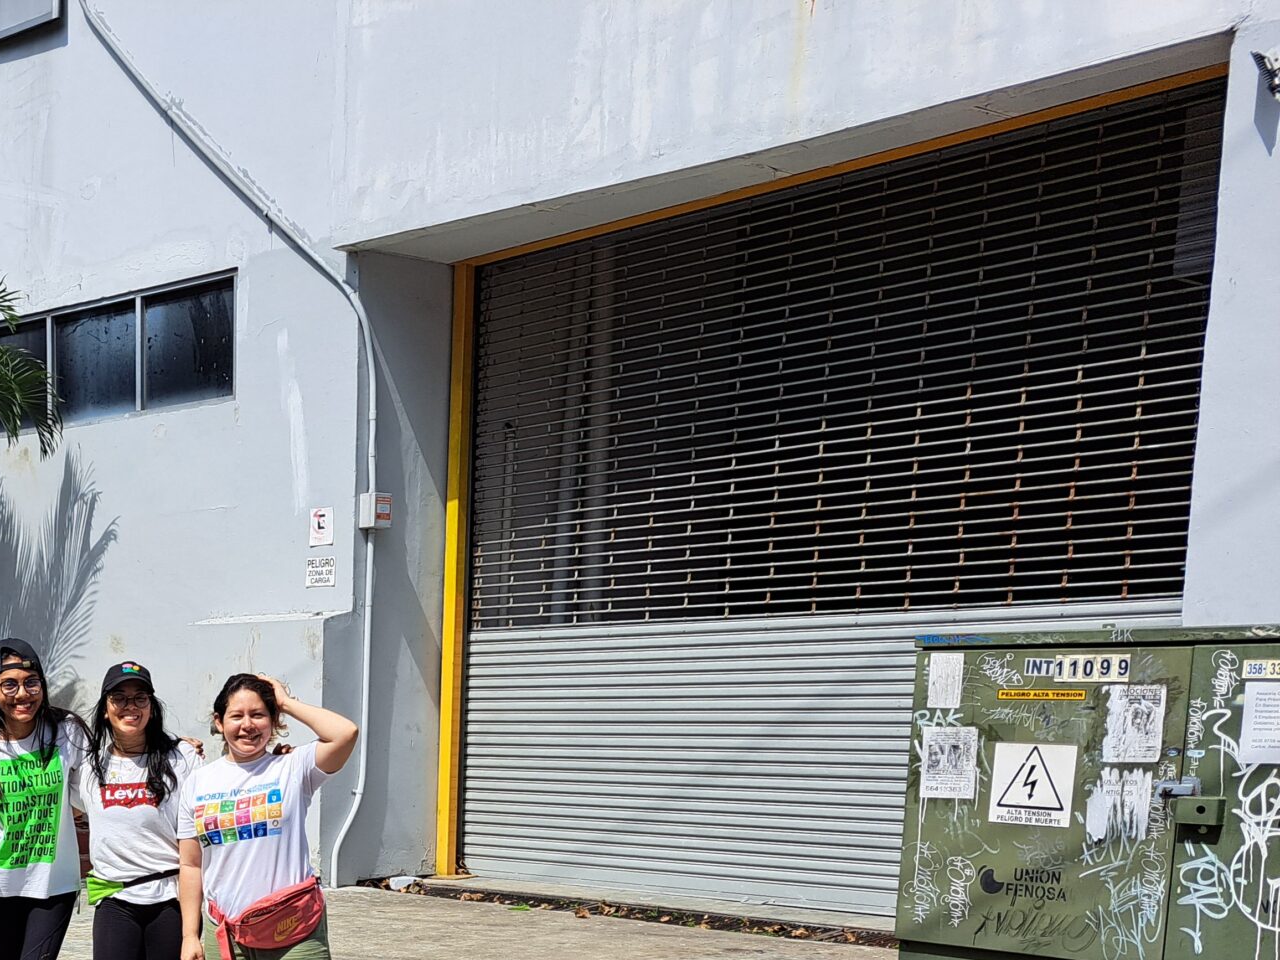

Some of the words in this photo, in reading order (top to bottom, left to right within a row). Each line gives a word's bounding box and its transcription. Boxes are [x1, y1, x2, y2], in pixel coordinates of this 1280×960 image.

[307, 557, 335, 569] PELIGRO
[308, 569, 324, 577] ZONA
[325, 568, 333, 576] DE
[310, 576, 331, 584] CARGA
[1025, 659, 1054, 675] INT
[1055, 659, 1129, 677] 11099
[1120, 688, 1162, 696] MOCIONES
[1024, 810, 1052, 818] TENSION
[996, 815, 1023, 823] PELIGRO
[1034, 818, 1062, 826] MUERTE
[1013, 868, 1062, 885] UNION
[1004, 882, 1067, 902] FENOSA
[276, 916, 299, 932] NIKE
